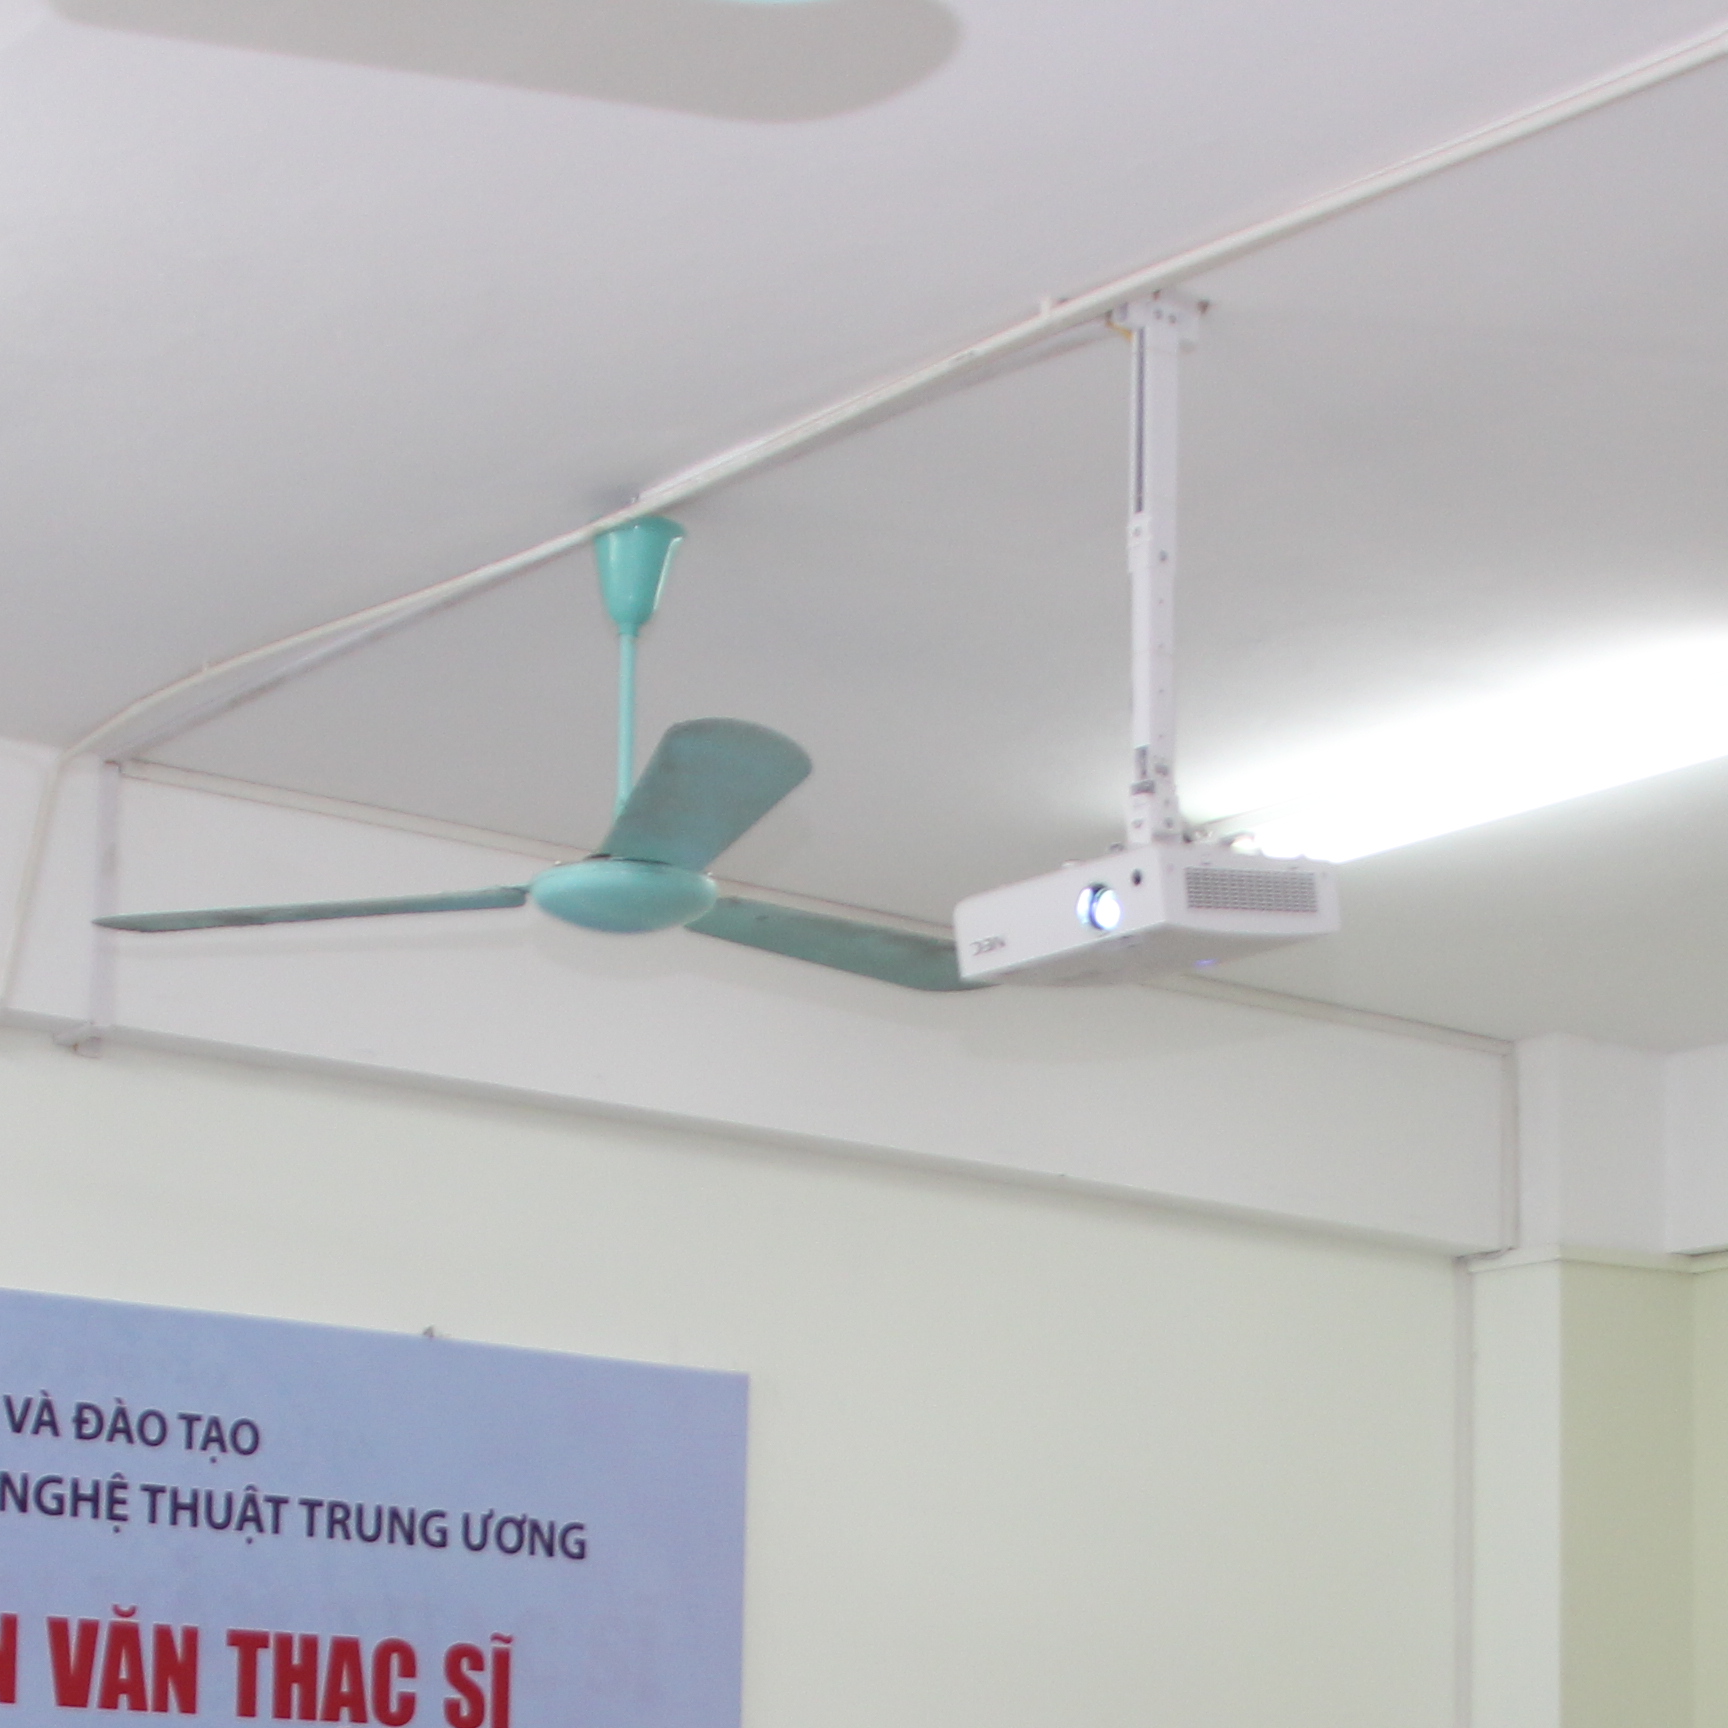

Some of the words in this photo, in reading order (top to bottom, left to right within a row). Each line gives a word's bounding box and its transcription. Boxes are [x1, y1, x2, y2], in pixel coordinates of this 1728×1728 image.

[4, 1391, 60, 1437] VÀ
[72, 1399, 168, 1447] ĐÀO
[178, 1414, 260, 1463] TẠO
[141, 1485, 289, 1544] THUẬT
[299, 1499, 448, 1549] TRUNG
[462, 1510, 586, 1560] ƯƠNG
[47, 1604, 200, 1716] VĂN
